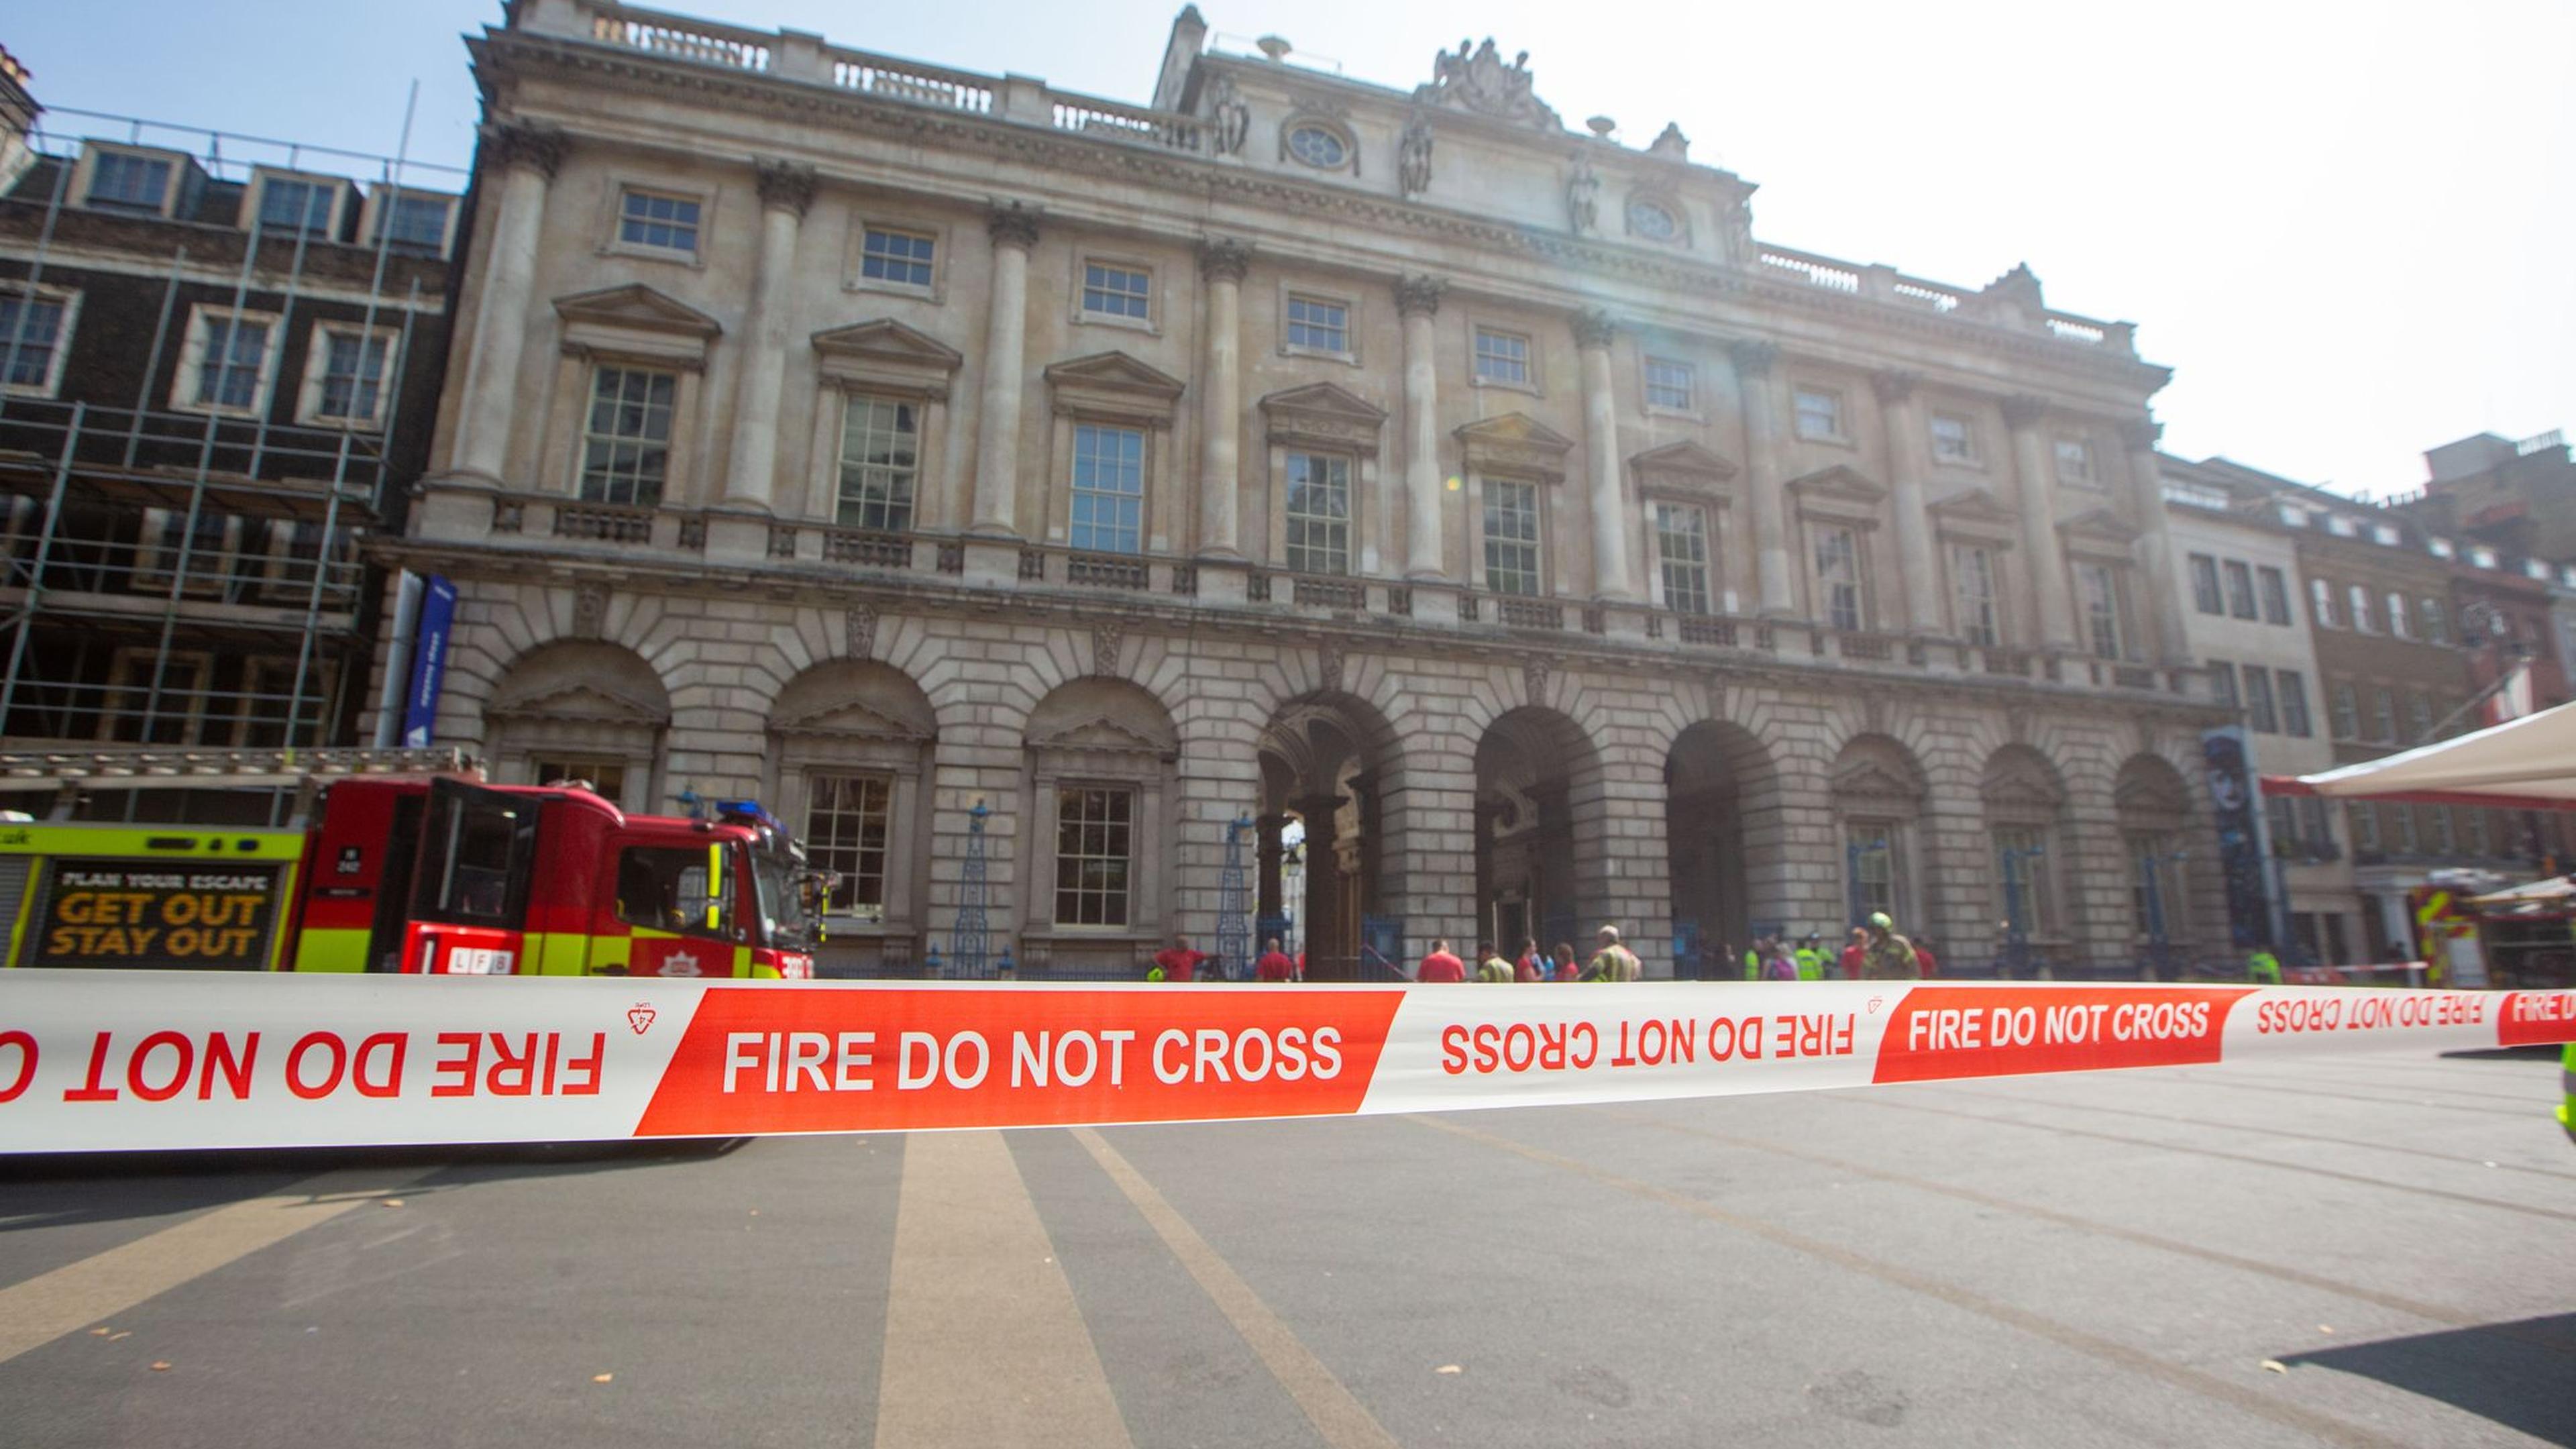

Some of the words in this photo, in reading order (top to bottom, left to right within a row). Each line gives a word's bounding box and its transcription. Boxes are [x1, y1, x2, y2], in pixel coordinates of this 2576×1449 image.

[62, 873, 121, 886] PLAN
[127, 874, 184, 889] YOUR
[190, 875, 268, 890] ESCAPE
[58, 893, 154, 924] GET
[162, 894, 266, 926] OUT
[48, 926, 158, 955] STAY
[165, 928, 258, 957] OUT
[1909, 1008, 1984, 1051] FIRE
[1990, 1006, 2036, 1046] DO
[2045, 1004, 2110, 1043] NOT
[2112, 1001, 2210, 1040] CROSS
[2257, 998, 2342, 1034] CROSS
[2345, 997, 2396, 1030] NOT
[2400, 996, 2434, 1028] DO
[2438, 995, 2485, 1026] FIRE
[2513, 994, 2561, 1022] FIRE
[723, 1032, 875, 1092] FIRE
[898, 1030, 989, 1089] DO
[1011, 1030, 1135, 1087] NOT
[1152, 1026, 1342, 1083] CROSS
[1441, 1022, 1599, 1075] CROSS
[1611, 1019, 1696, 1067] NOT
[1708, 1016, 1764, 1062] DO
[1775, 1014, 1855, 1059] FIRE
[62, 1030, 261, 1102] NOT
[285, 1030, 409, 1099] DO
[431, 1032, 606, 1097] FIRE
